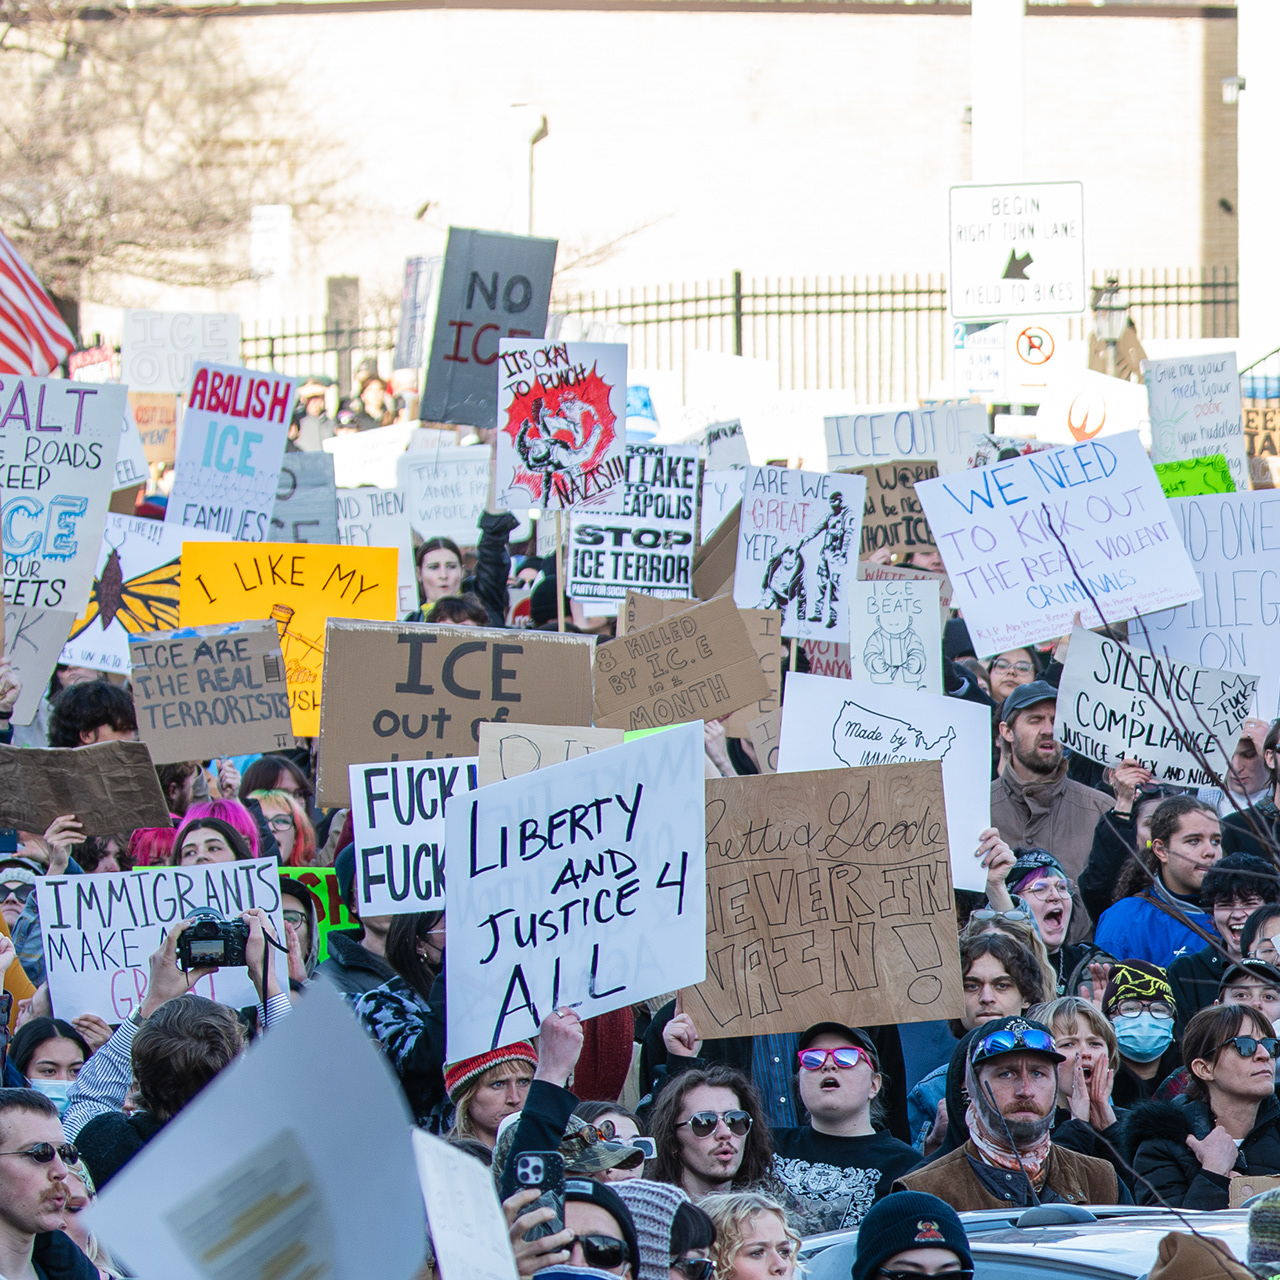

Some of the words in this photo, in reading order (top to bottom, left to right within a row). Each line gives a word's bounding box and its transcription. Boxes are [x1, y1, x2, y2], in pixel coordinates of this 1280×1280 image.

[991, 197, 1040, 215] BEGIN
[956, 224, 992, 243] RIGHT
[1002, 222, 1035, 240] TURN
[1043, 222, 1078, 239] LANE
[466, 271, 533, 314] NO
[189, 368, 290, 423] ABOLISH
[503, 380, 530, 399] TO
[538, 363, 586, 394] PUNCH
[25, 437, 102, 469] ROADS
[202, 422, 264, 475] ICE
[828, 417, 883, 457] ICE
[898, 411, 935, 455] OUT
[640, 457, 692, 489] LAKE
[752, 470, 788, 495] ARE
[801, 475, 830, 499] WE
[943, 463, 1028, 515] WE
[1033, 441, 1117, 492] NEED
[751, 499, 810, 533] GREAT
[941, 525, 996, 560] TO
[1011, 500, 1070, 548] KICK
[1086, 486, 1145, 524] OUT
[573, 525, 692, 549] STOP
[743, 533, 778, 561] YET?
[234, 555, 305, 590] LIKE
[321, 563, 379, 604] MY
[572, 549, 605, 577] ICE
[611, 552, 689, 583] TERROR
[955, 561, 1019, 598] THE
[1019, 549, 1092, 583] REAL
[1096, 521, 1171, 561] VIOLENT
[572, 584, 594, 595] PARTY
[867, 598, 922, 614] BEATS
[1026, 569, 1136, 609] CRIMINALS
[134, 643, 186, 668] ICE
[192, 637, 250, 663] ARE
[625, 616, 696, 657] KILLED
[137, 672, 193, 698] THE
[200, 667, 262, 691] REAL
[395, 635, 522, 701] ICE
[608, 673, 640, 697] BY
[1093, 641, 1210, 704] SILENCE
[629, 683, 729, 730] MONTH
[1220, 688, 1251, 715] FUCK
[1231, 702, 1249, 723] ICE
[372, 712, 450, 739] out
[844, 719, 884, 742] Made
[890, 728, 908, 748] by
[1076, 690, 1216, 754] COMPLIANCE
[1059, 722, 1111, 764] JUSTICE
[1162, 764, 1187, 781] AND
[470, 782, 642, 878] LIBERTY
[551, 850, 637, 894] AND
[880, 861, 950, 916] IN
[48, 864, 280, 930] IMMIGRANTS
[478, 880, 640, 964] JUSTICE
[656, 852, 688, 914] 4
[48, 930, 141, 973] MAKE
